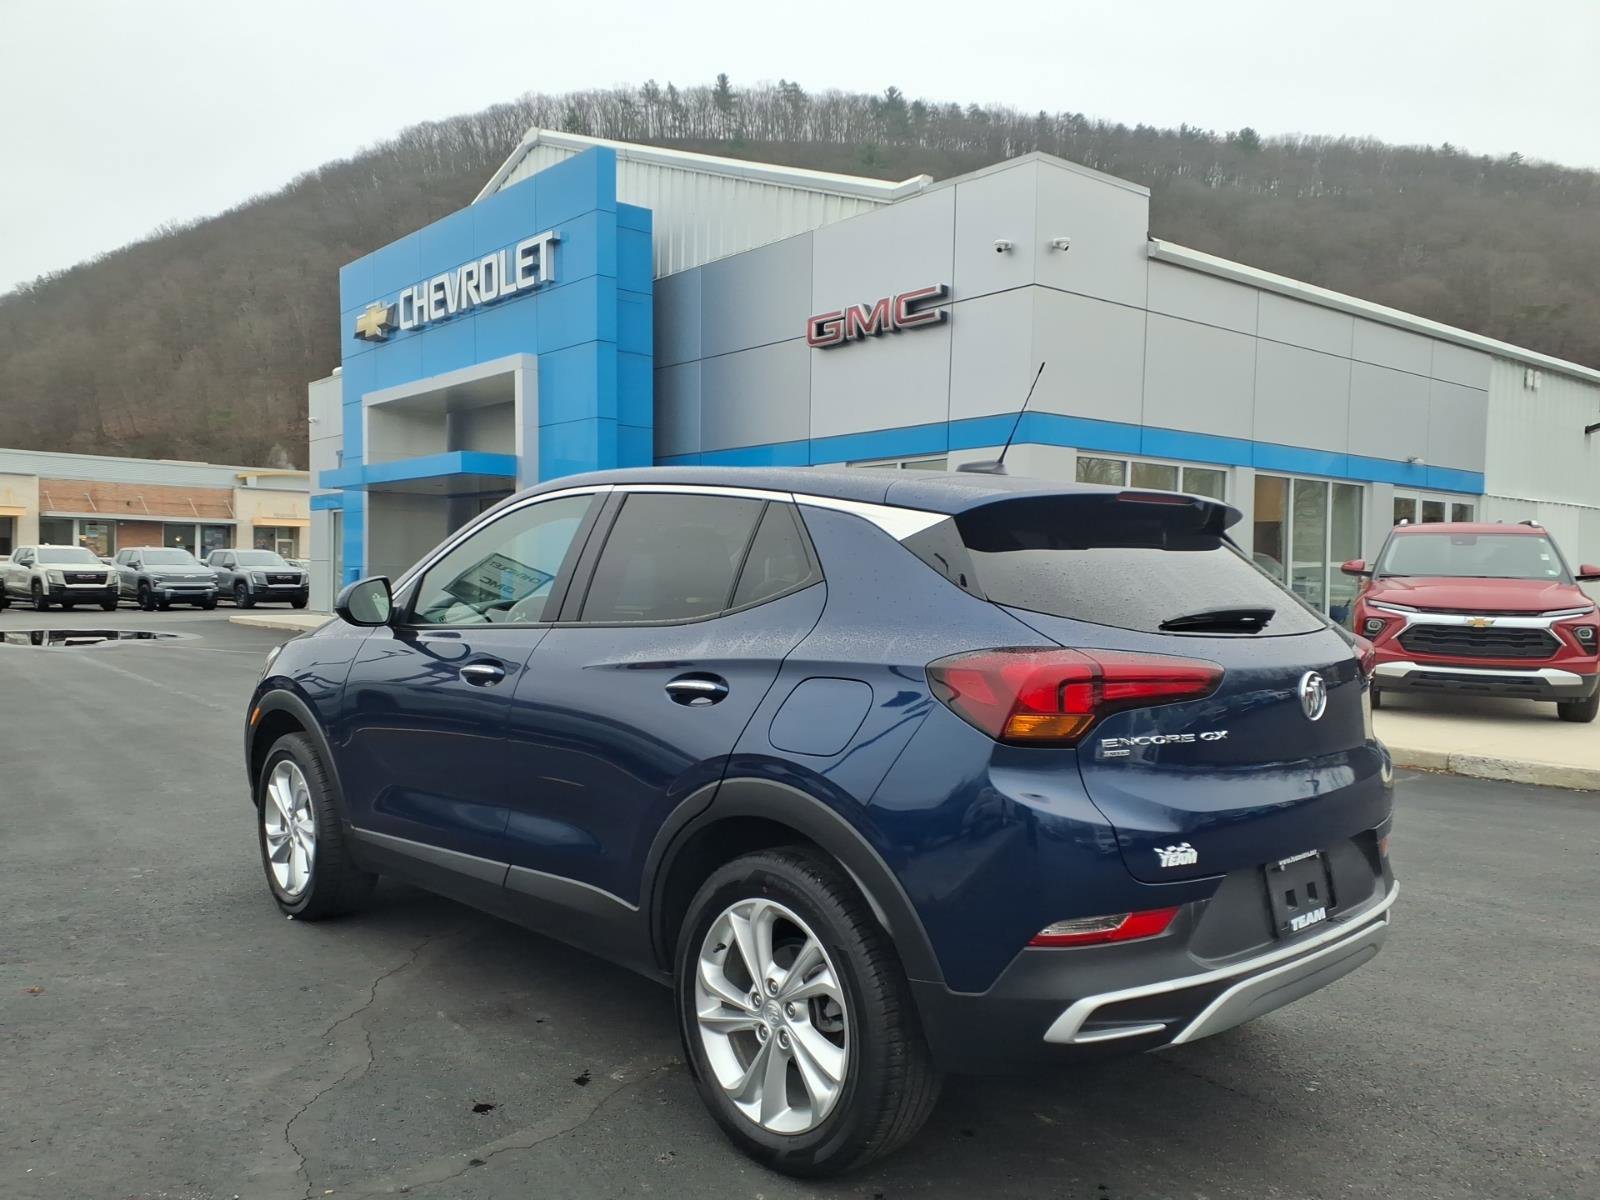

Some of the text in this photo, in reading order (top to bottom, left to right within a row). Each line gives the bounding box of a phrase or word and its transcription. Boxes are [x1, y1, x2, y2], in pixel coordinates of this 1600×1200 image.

[399, 230, 560, 331] CHEVROLET
[806, 283, 947, 348] GMC
[1101, 730, 1229, 748] ENCORE GX
[1160, 850, 1198, 868] TEAM
[1291, 907, 1326, 931] TEAM
